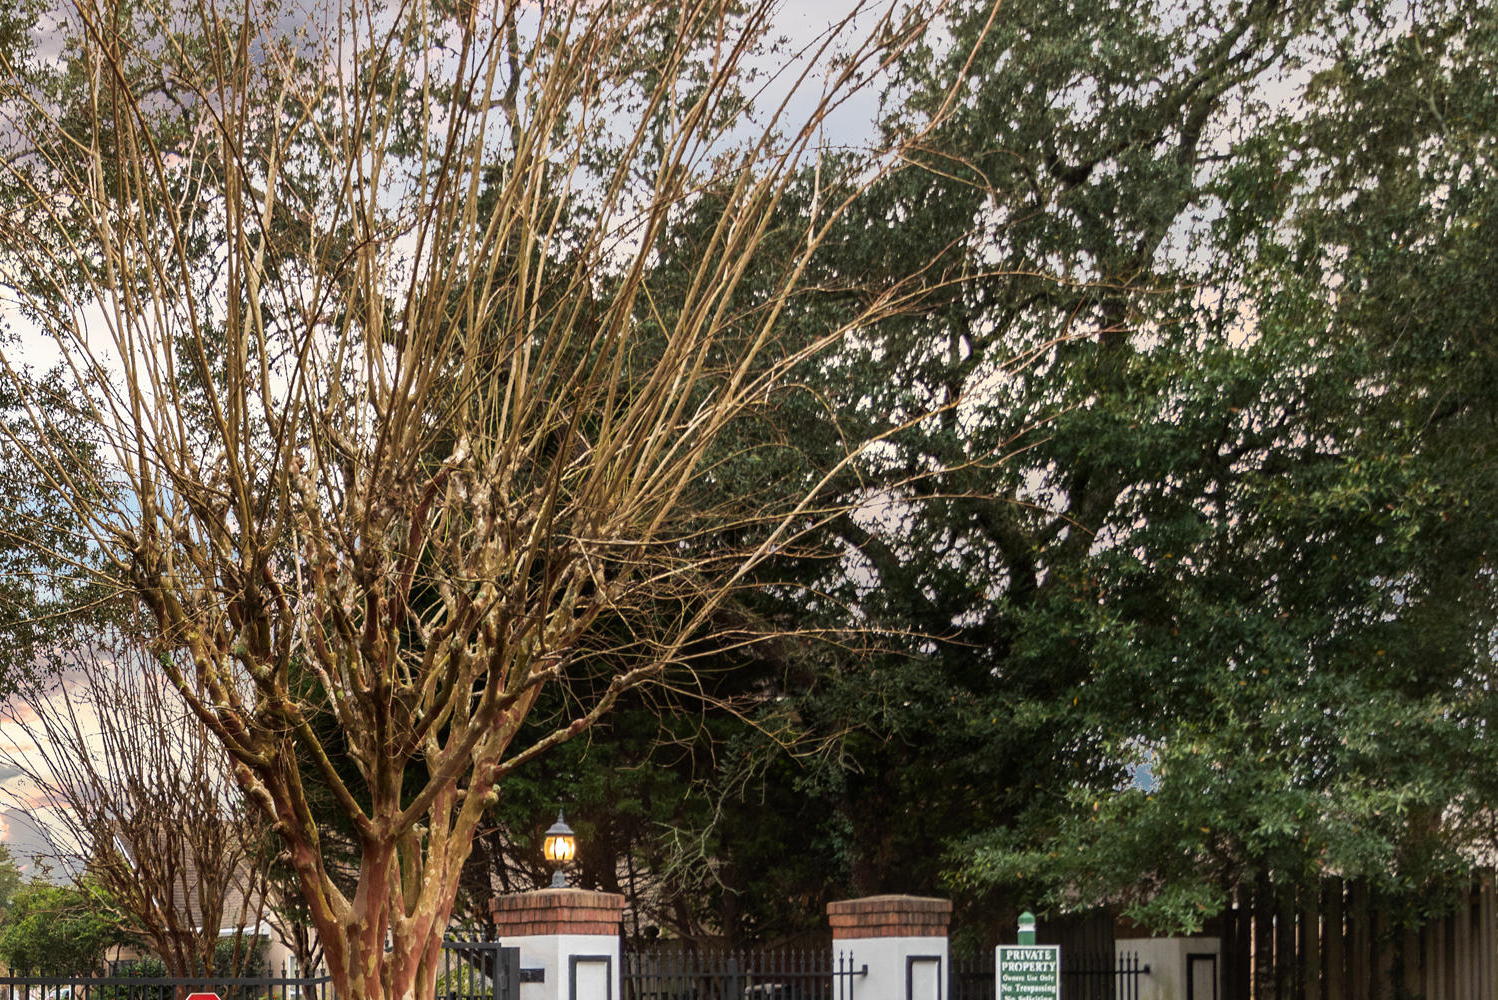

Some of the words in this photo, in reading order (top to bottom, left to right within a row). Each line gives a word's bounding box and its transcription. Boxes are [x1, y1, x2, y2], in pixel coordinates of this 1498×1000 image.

[1006, 950, 1051, 960] PRIVATE
[1002, 961, 1056, 972] PROPERTY
[1039, 974, 1054, 982] Only
[1002, 984, 1012, 992] No
[1015, 984, 1056, 994] Trespassing
